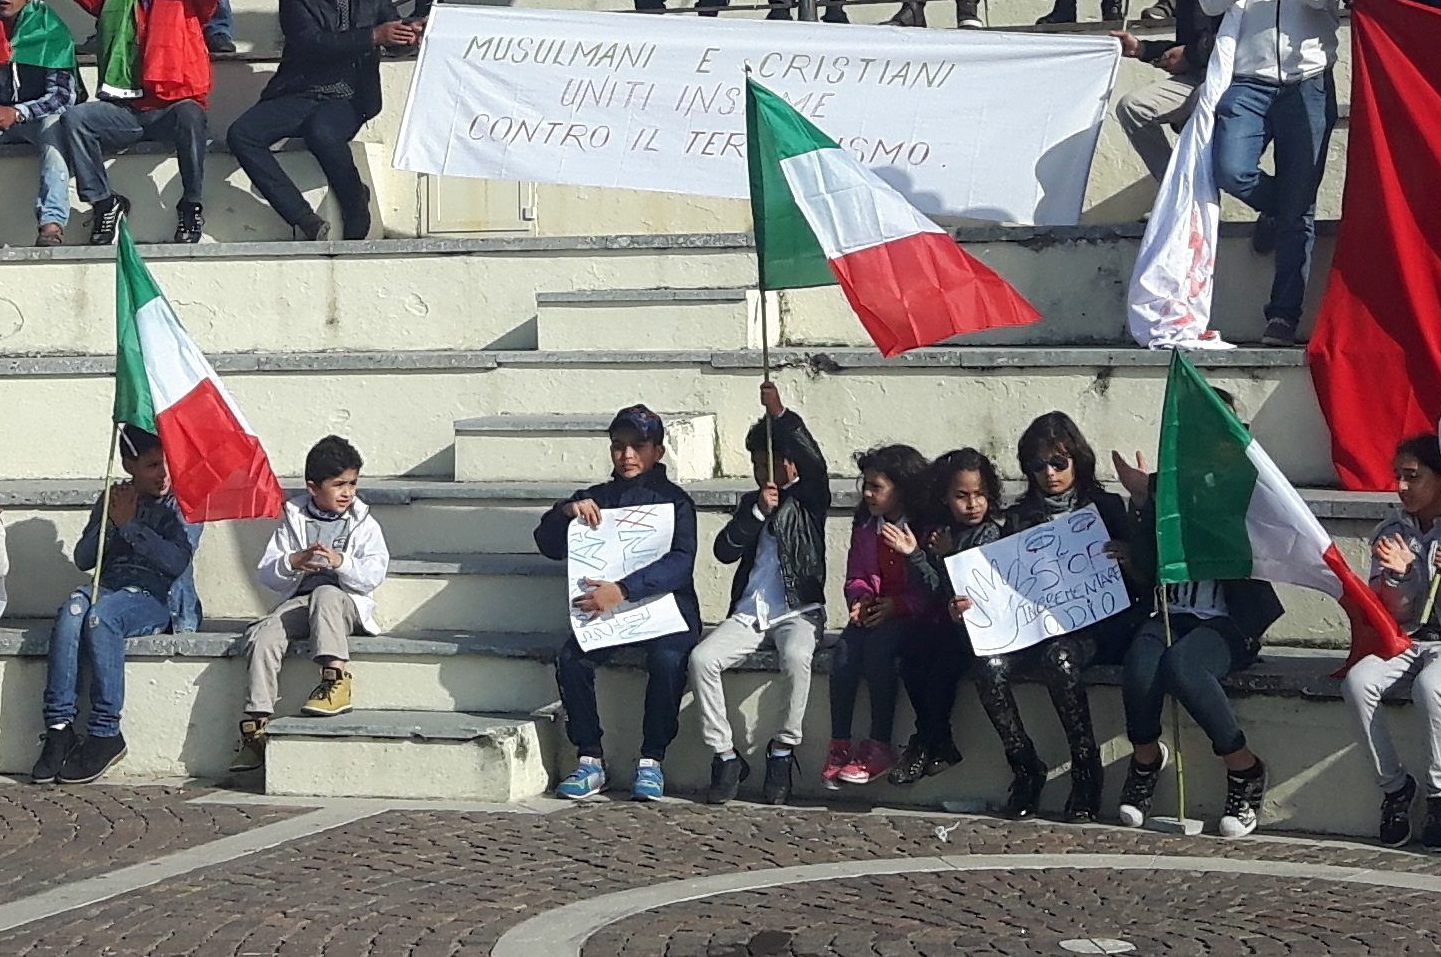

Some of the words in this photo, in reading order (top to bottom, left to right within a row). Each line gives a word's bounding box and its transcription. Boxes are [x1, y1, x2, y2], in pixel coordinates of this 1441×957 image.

[462, 34, 657, 73] MUSULMANI
[695, 46, 722, 74] E
[758, 51, 957, 90] CRISTIANI
[560, 75, 655, 113] UNITI
[674, 82, 836, 118] INSME
[468, 113, 611, 153] CONTRO
[630, 127, 660, 153] IL
